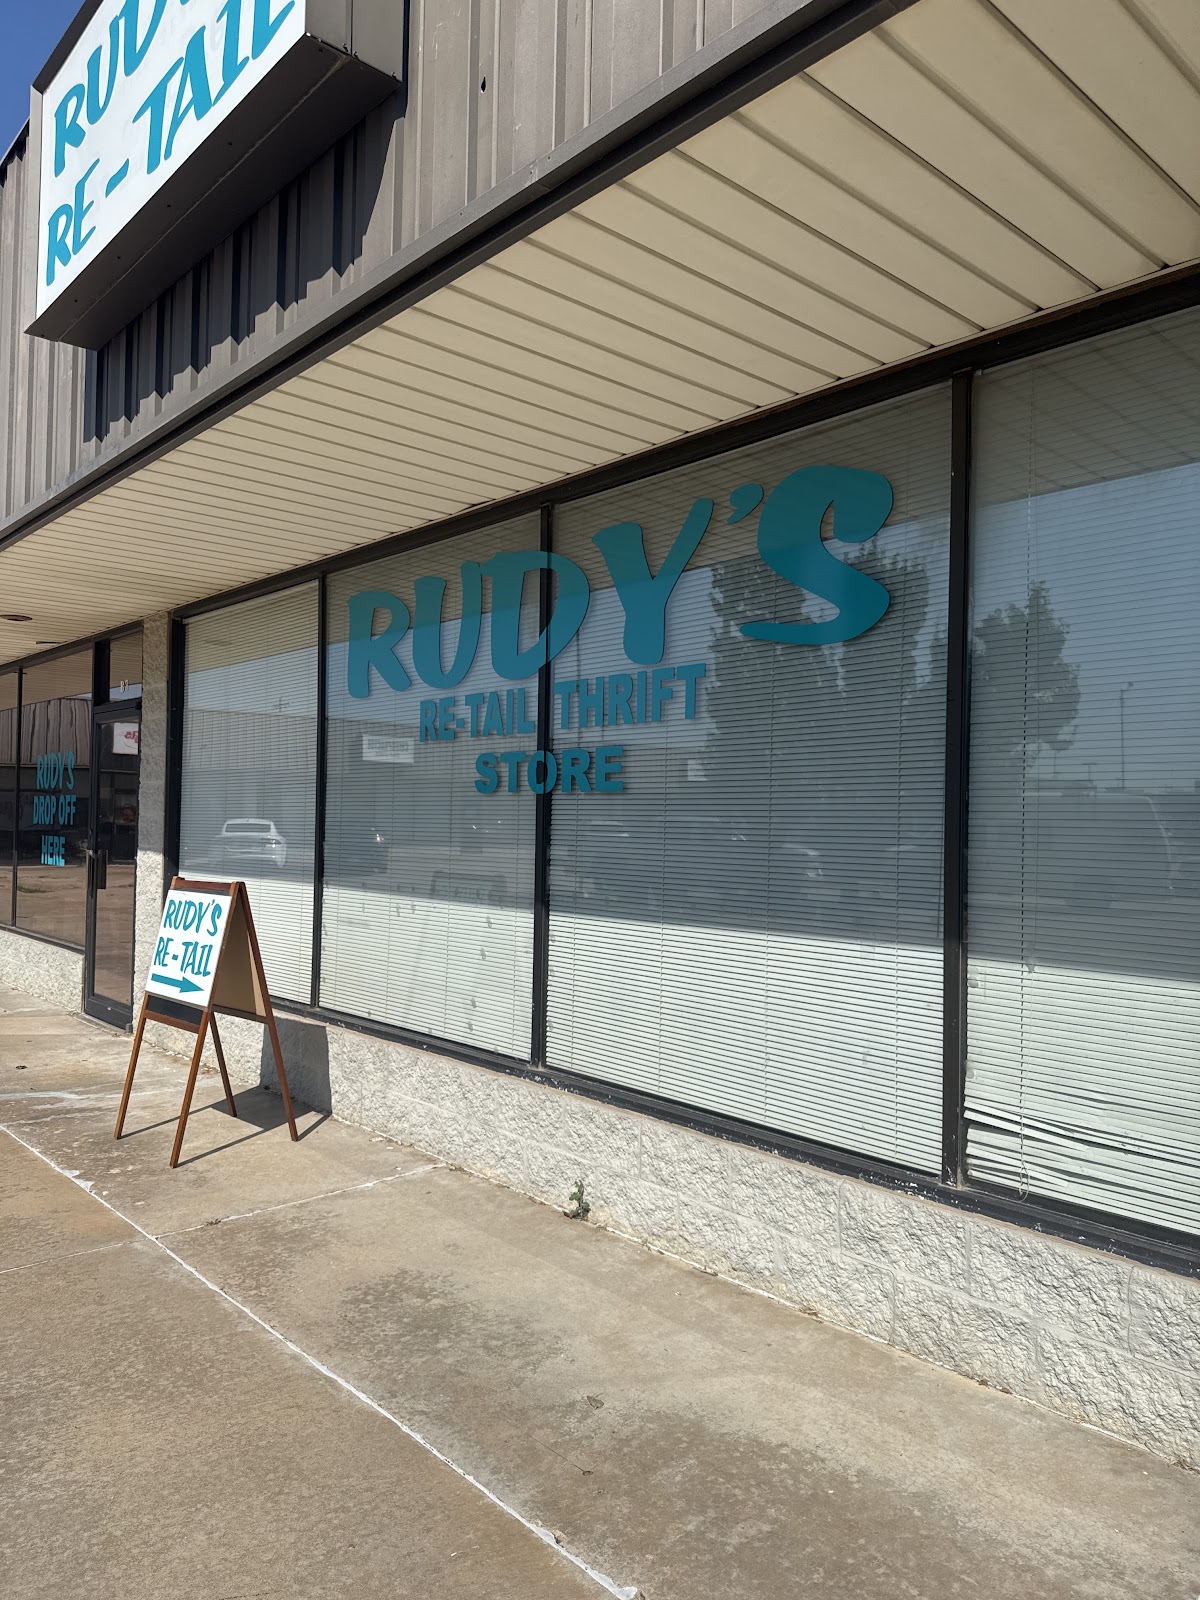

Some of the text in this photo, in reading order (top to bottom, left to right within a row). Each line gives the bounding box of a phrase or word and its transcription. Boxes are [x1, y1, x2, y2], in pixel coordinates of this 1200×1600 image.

[54, 0, 189, 178] RUD
[347, 465, 894, 698] RUDY'S
[419, 663, 706, 742] RE-TAIL THRIFT
[36, 751, 75, 790] RUDY'S
[474, 745, 624, 794] STORE
[33, 794, 77, 826] DROP OFF
[41, 835, 66, 867] HERE
[163, 899, 222, 937] RUDY'S
[153, 936, 214, 977] RE-TAIL
